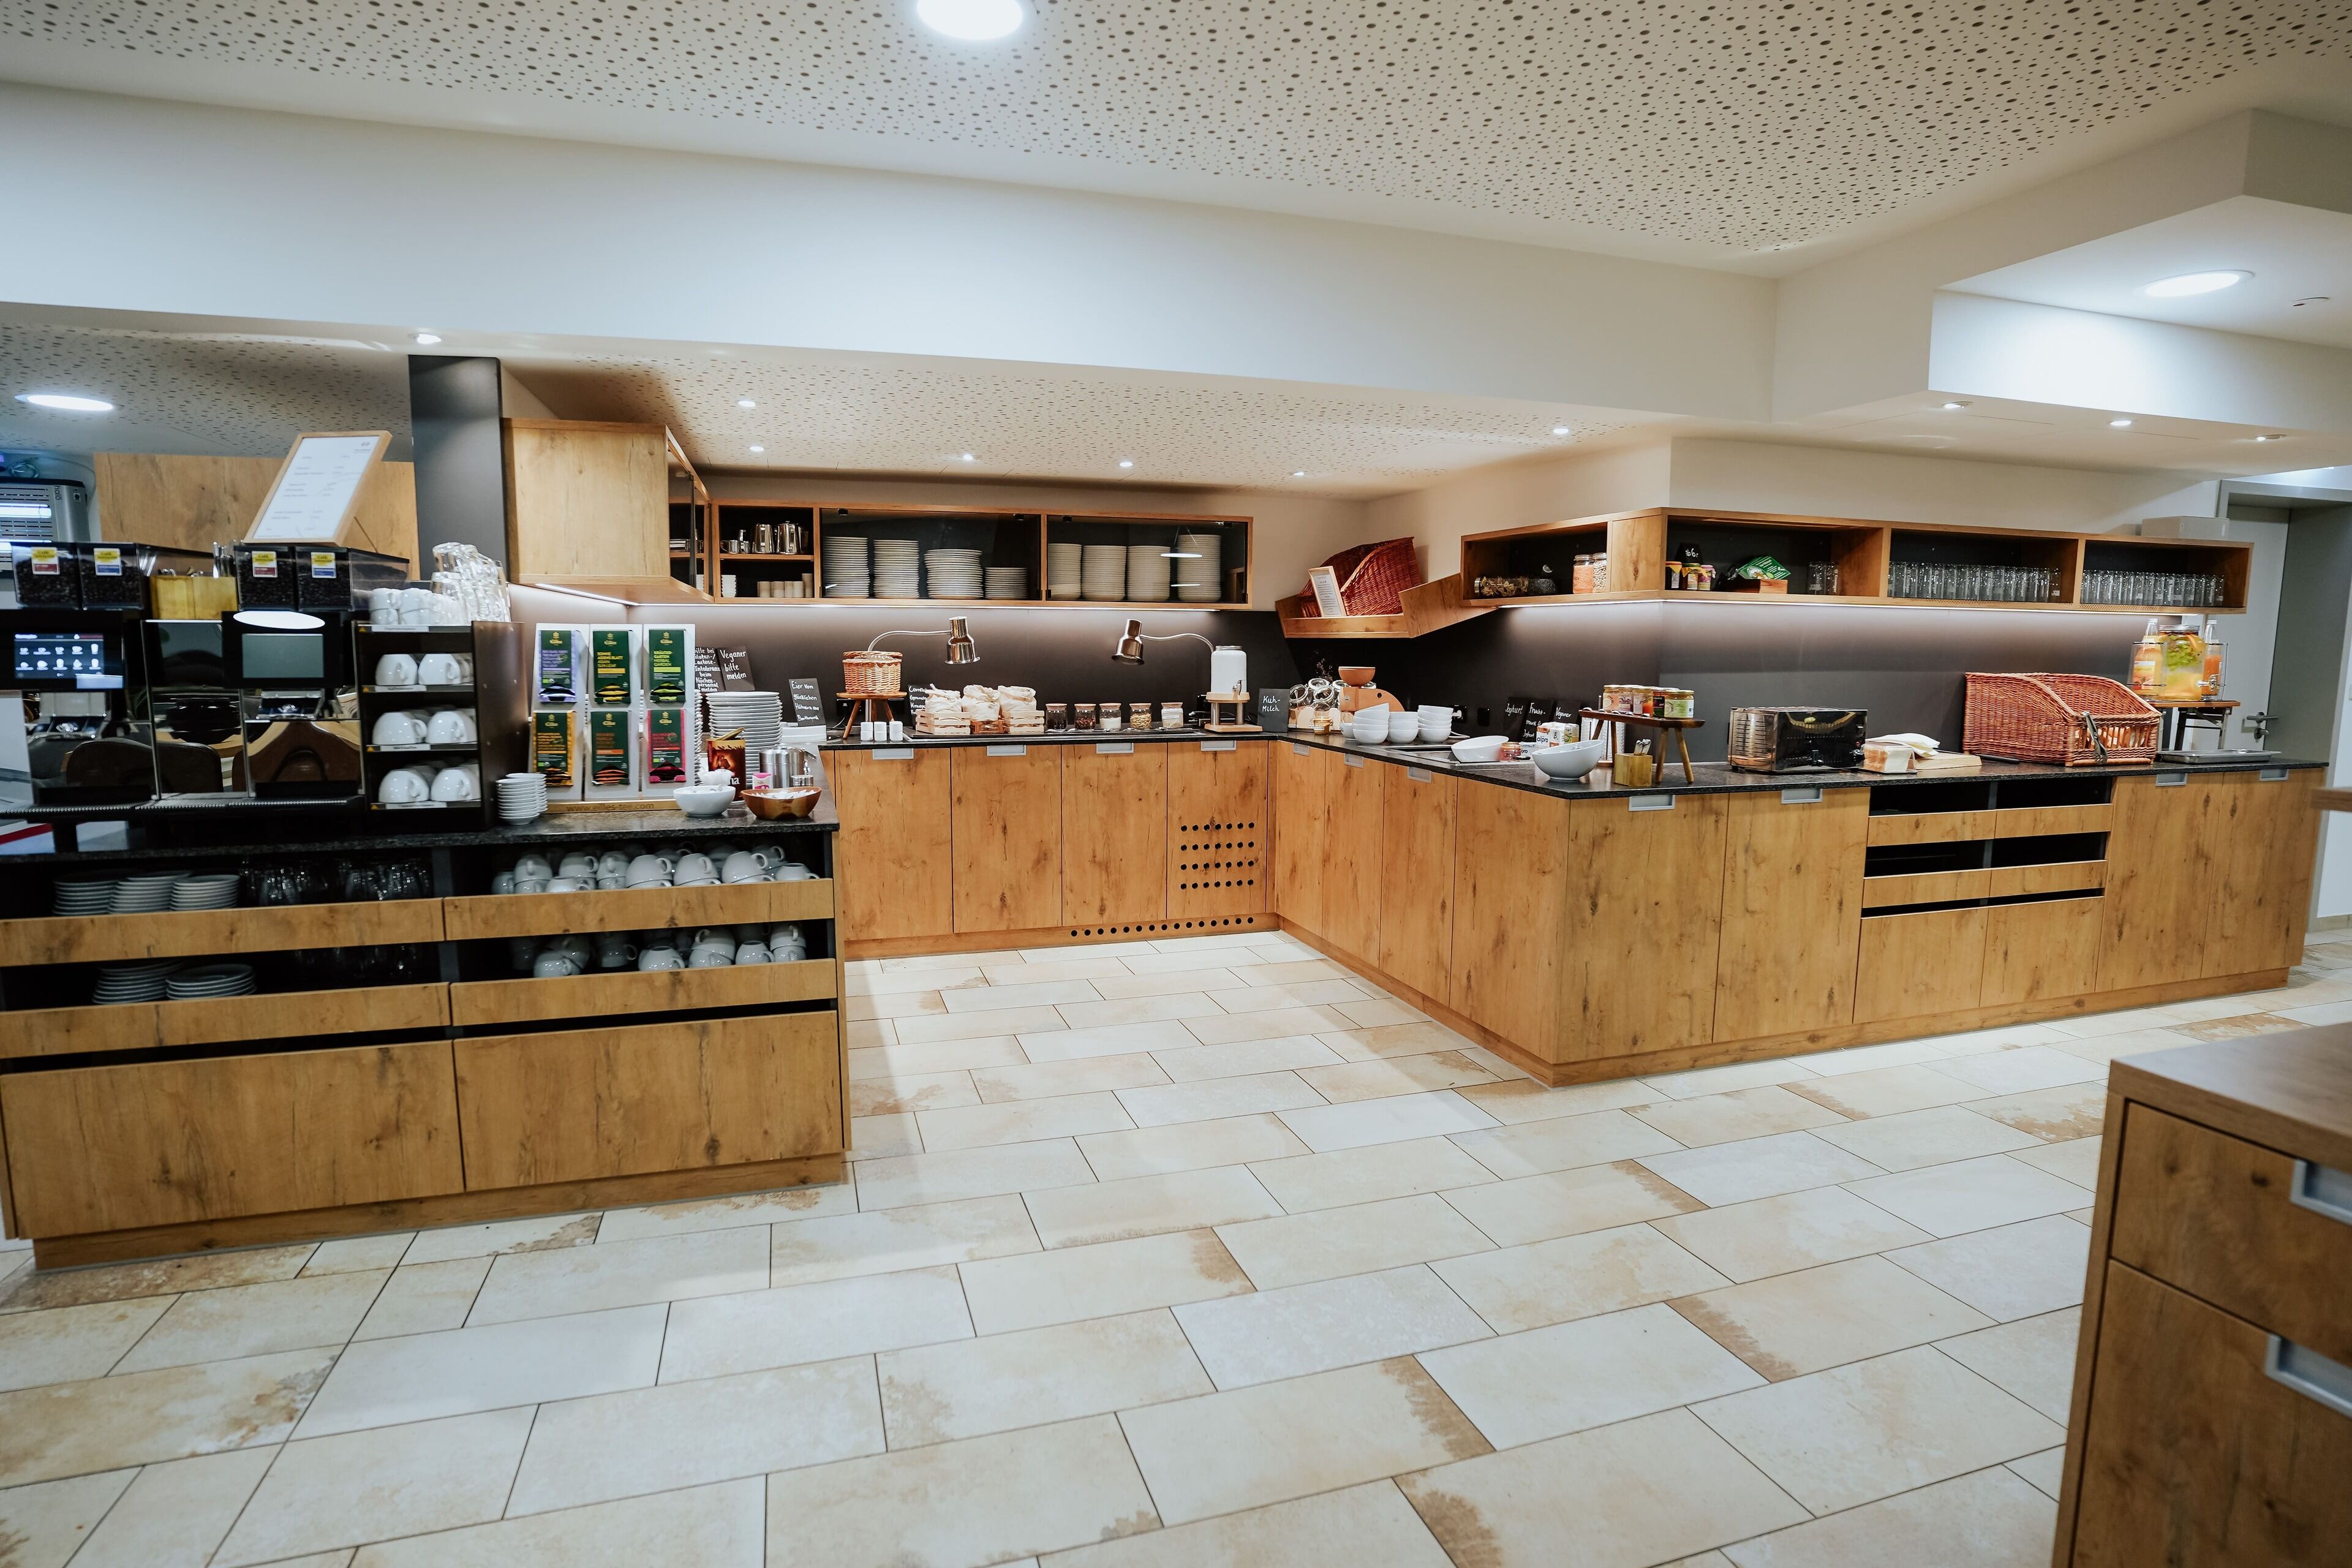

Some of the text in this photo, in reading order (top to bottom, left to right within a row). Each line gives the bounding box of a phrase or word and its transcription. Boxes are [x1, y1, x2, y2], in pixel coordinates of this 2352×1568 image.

[720, 649, 747, 663] Veganer
[724, 663, 740, 672] bitte
[726, 672, 747, 680] melden
[791, 680, 803, 689] Eier
[1262, 695, 1281, 704] Kuh-
[1505, 703, 1524, 717] Joghurt
[1529, 702, 1546, 715] Frucht-
[1555, 706, 1572, 720] Veganer
[566, 802, 655, 813] www.eilles-tee.com
